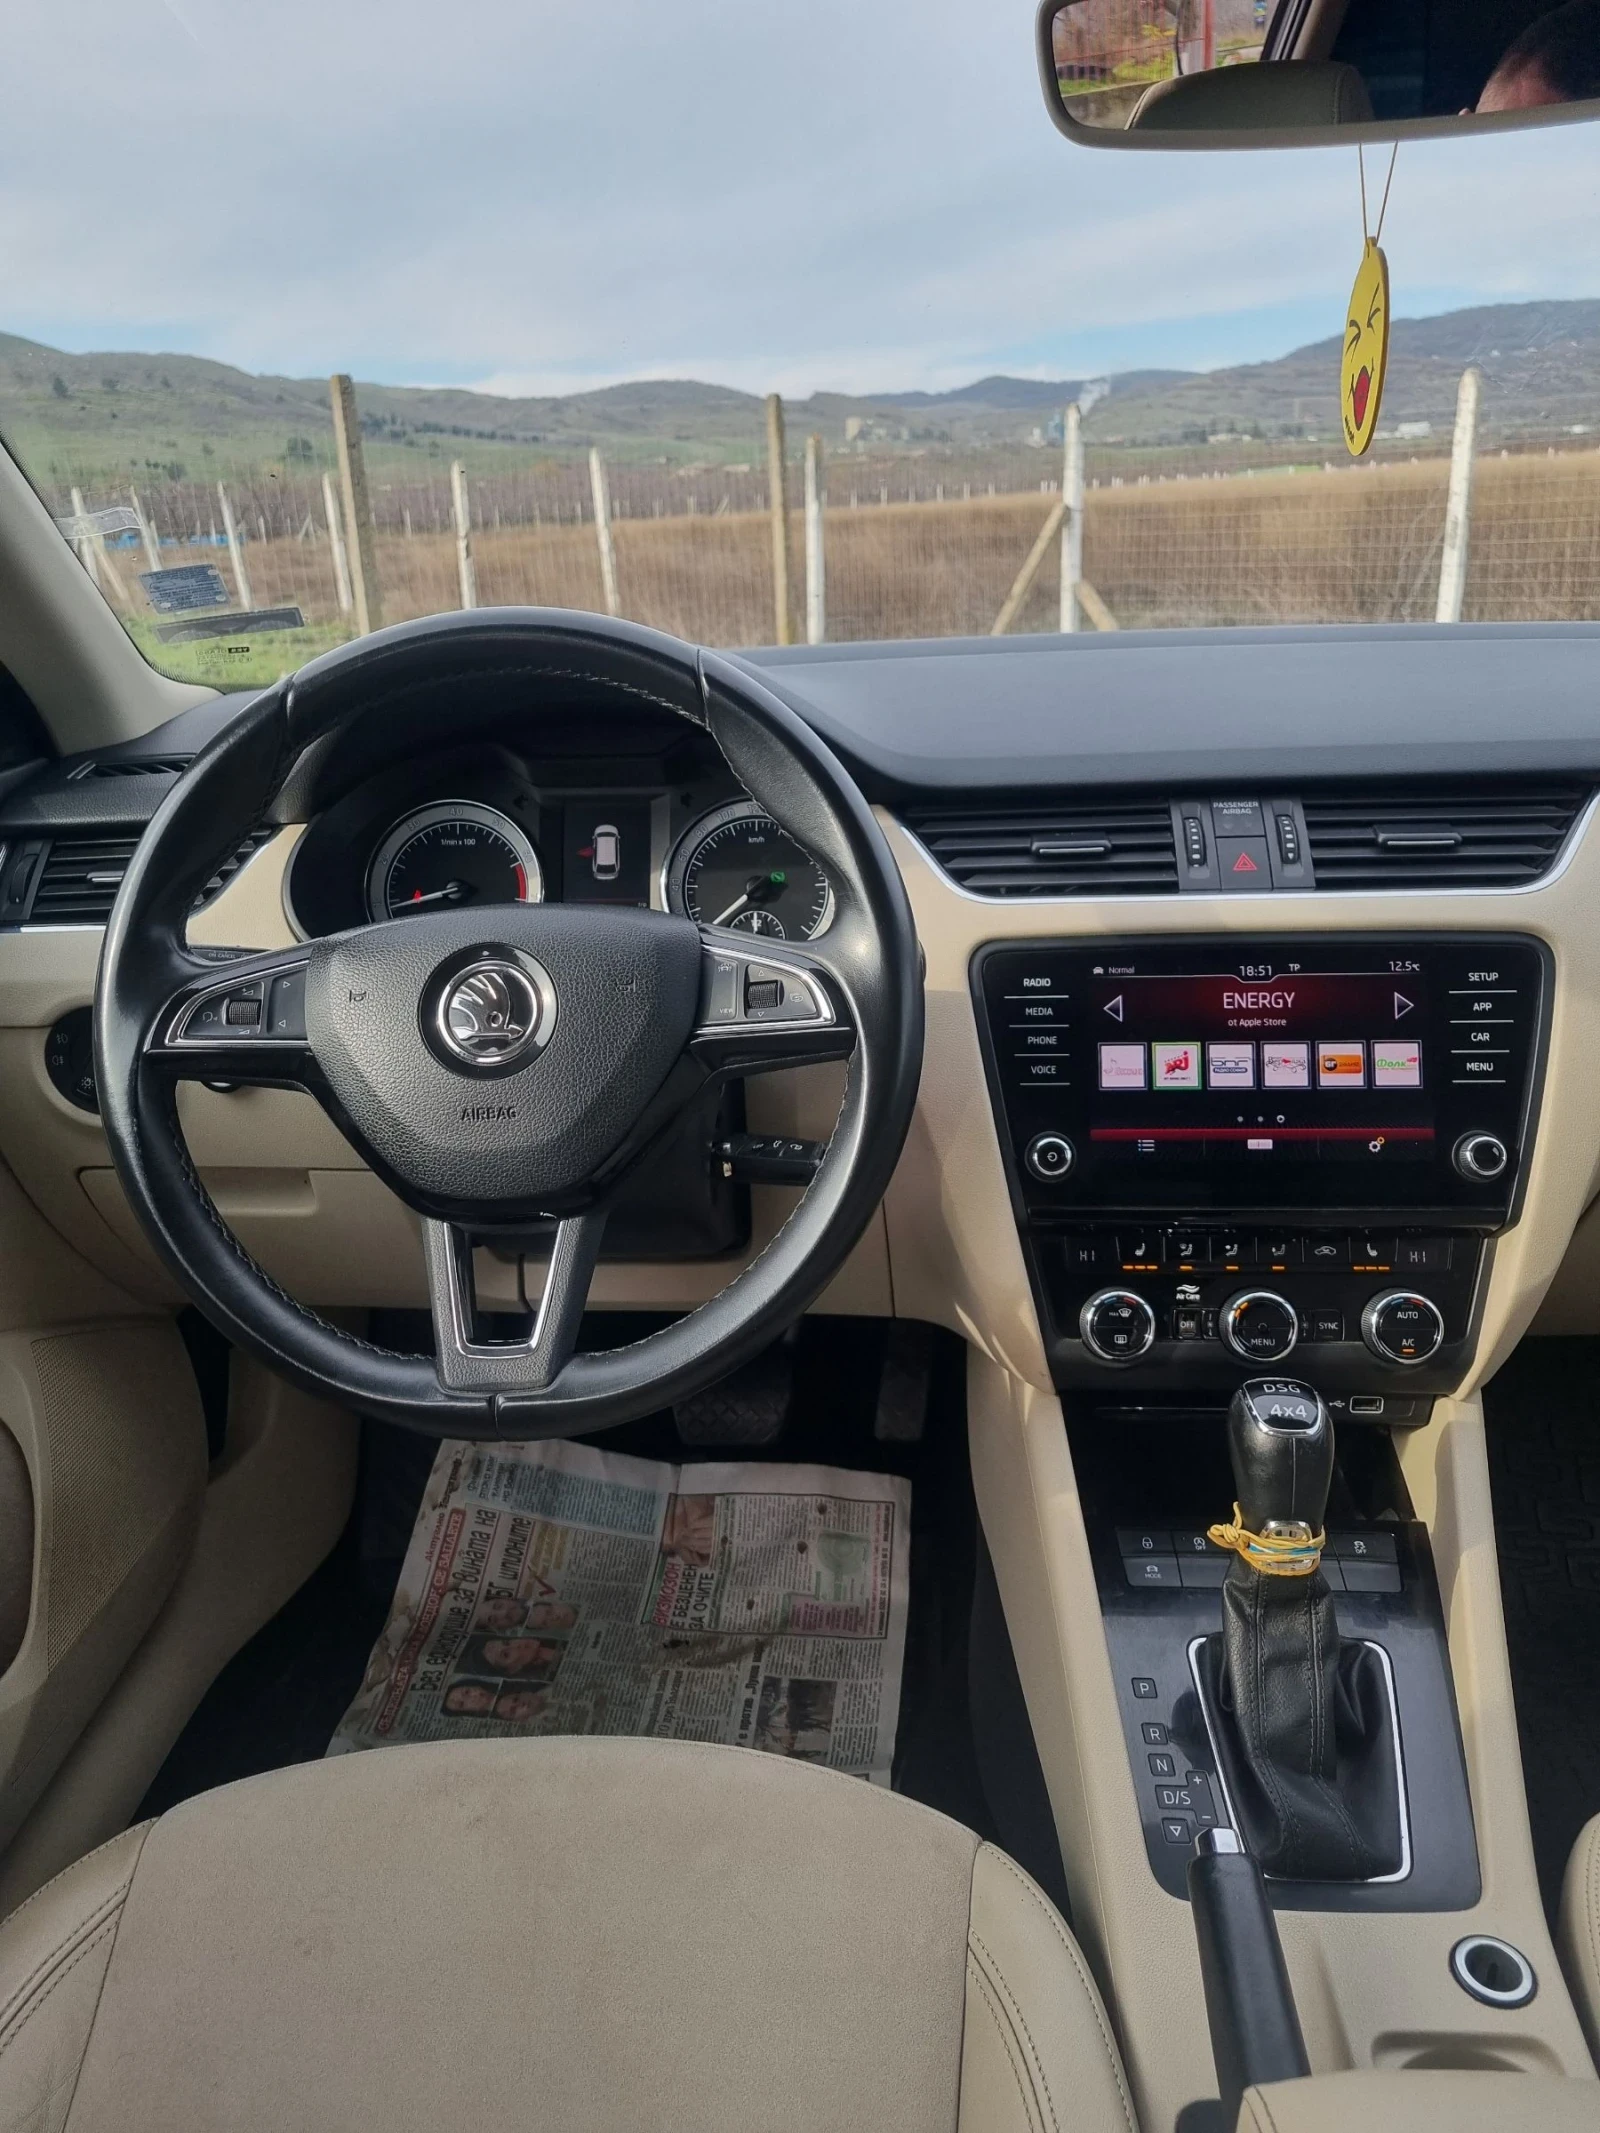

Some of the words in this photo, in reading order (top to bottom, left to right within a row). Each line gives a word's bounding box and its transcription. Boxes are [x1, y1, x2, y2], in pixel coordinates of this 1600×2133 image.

[450, 807, 463, 816] 40
[717, 807, 735, 822] 100
[407, 819, 421, 831] 30
[492, 817, 506, 829] 50
[695, 824, 709, 839] 80
[748, 836, 765, 844] km/h
[679, 848, 690, 863] 60
[1108, 966, 1135, 975] Normal
[1239, 965, 1273, 977] 18:51
[1288, 964, 1300, 972] TP
[1468, 972, 1499, 981] SETUP
[1023, 978, 1051, 987] RADIO
[1223, 992, 1296, 1009] ENERGY
[1473, 1002, 1492, 1011] APP
[1025, 1007, 1053, 1016] MEDIA
[1239, 1017, 1261, 1028] Apple
[1263, 1017, 1287, 1026] Store
[1027, 1036, 1057, 1045] PHONE
[1470, 1032, 1490, 1041] CAR
[1030, 1065, 1057, 1074] VOICE
[1466, 1062, 1494, 1071] MENU
[461, 1107, 517, 1121] AIRBAG
[1397, 1311, 1419, 1319] AUTO
[1180, 1321, 1195, 1329] OFF
[1318, 1322, 1339, 1330] SYNC
[1250, 1338, 1275, 1346] MENU
[1402, 1338, 1415, 1347] A/C
[1263, 1383, 1300, 1393] DSG
[1270, 1404, 1307, 1418] 4x4
[476, 1508, 497, 1528] на
[499, 1517, 532, 1581] шпионите
[452, 1530, 492, 1584] вината
[453, 1588, 475, 1605] за
[653, 1563, 682, 1625] ВИЗИОЗОН
[672, 1564, 697, 1618] БЕЗЦЕНЕН
[693, 1572, 714, 1612] ОЧИТЕ
[689, 1614, 704, 1630] ЗА
[410, 1669, 443, 1691] Без
[1139, 1683, 1150, 1695] P
[740, 1698, 754, 1730] против
[1150, 1728, 1161, 1741] R
[1156, 1759, 1168, 1772] N
[1163, 1791, 1191, 1805] D/S
